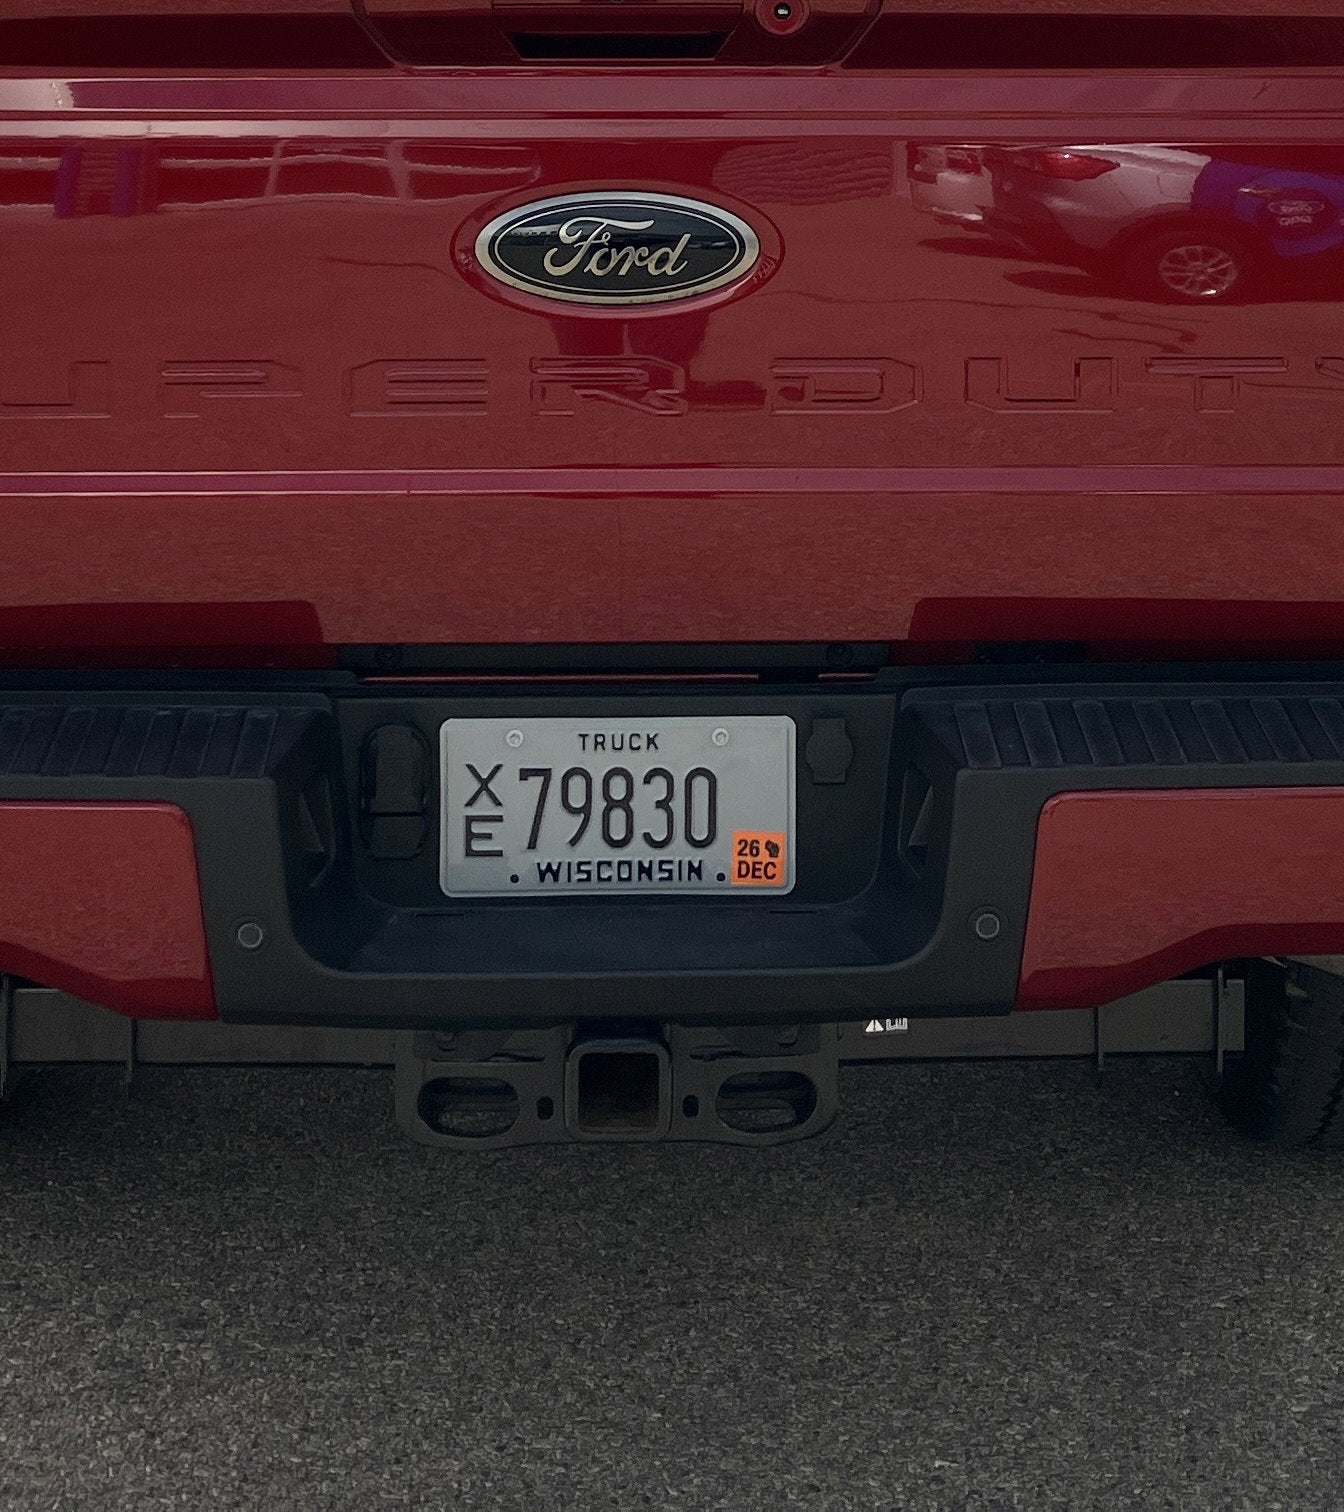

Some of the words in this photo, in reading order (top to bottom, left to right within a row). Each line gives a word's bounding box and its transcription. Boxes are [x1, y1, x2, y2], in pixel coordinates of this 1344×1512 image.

[543, 216, 693, 277] Ford
[578, 733, 660, 752] TRUCK
[518, 767, 718, 851] 79830
[737, 839, 761, 858] 26
[536, 859, 703, 883] WISCONSIN
[737, 861, 777, 881] DEC
